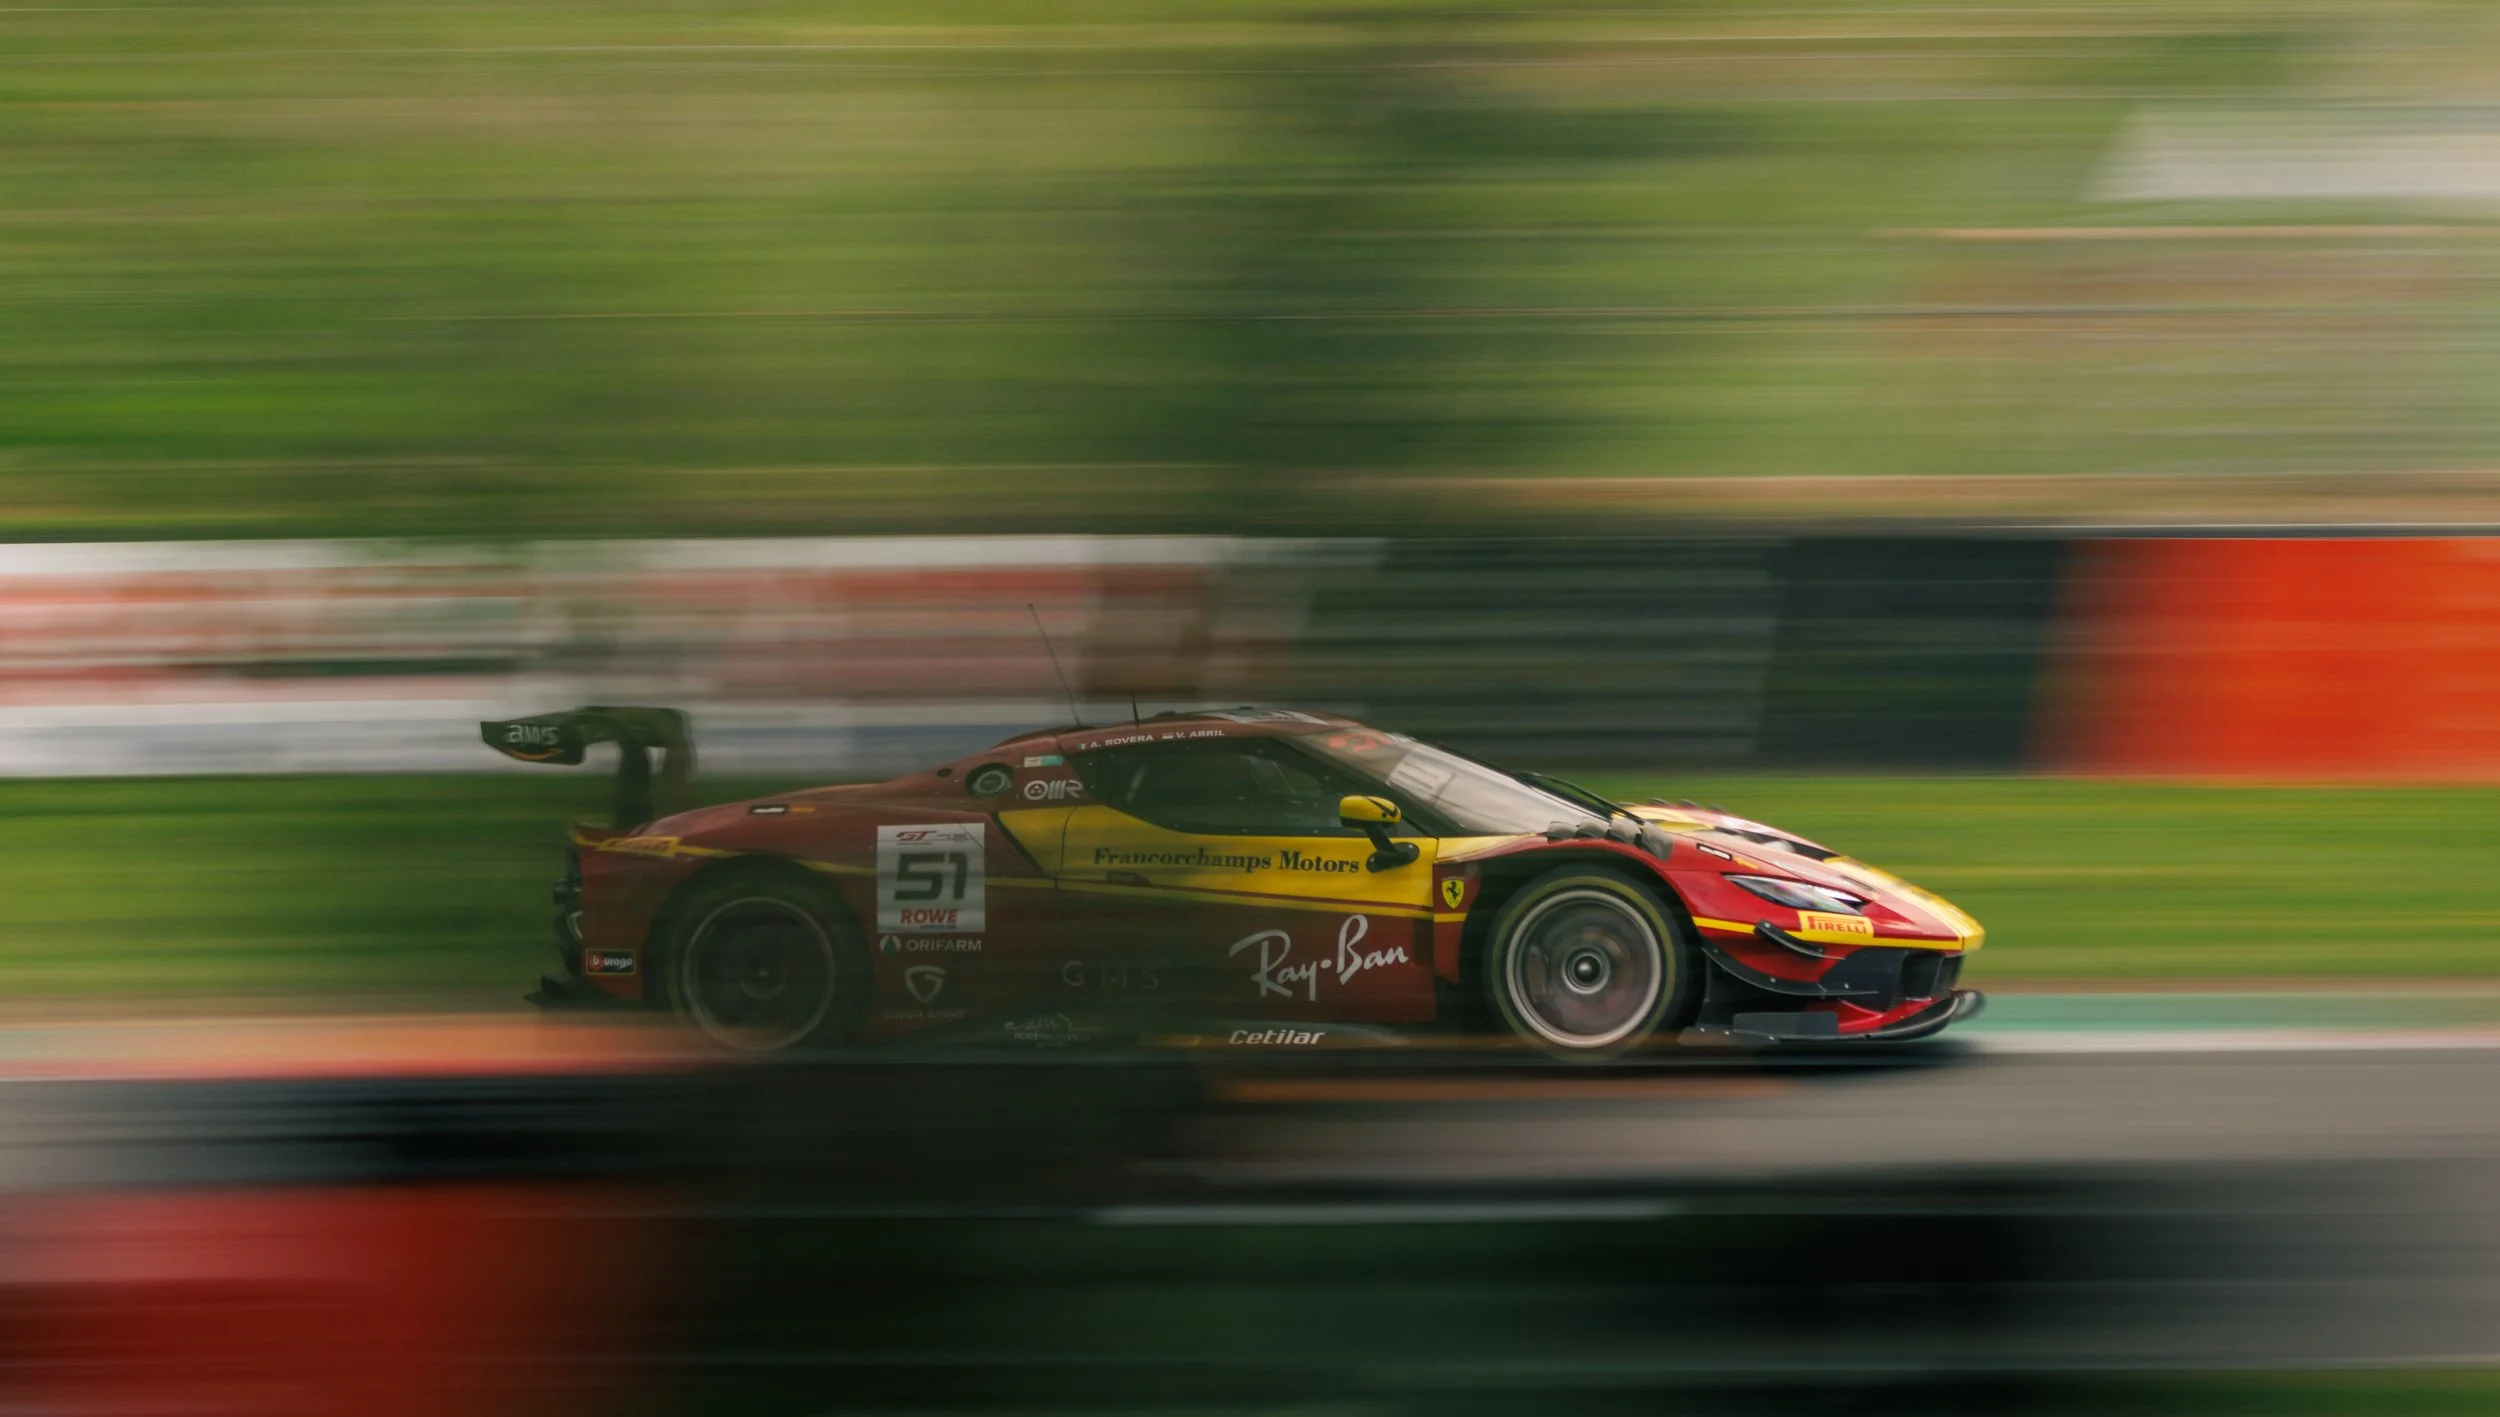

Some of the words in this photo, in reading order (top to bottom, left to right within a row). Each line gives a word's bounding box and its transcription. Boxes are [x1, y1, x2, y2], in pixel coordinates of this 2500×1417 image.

[507, 724, 558, 745] aws
[1105, 734, 1153, 746] ROVERA
[1189, 729, 1225, 738] ABRIL
[1094, 847, 1271, 874] Francorchamps
[1278, 850, 1360, 873] Motors
[894, 852, 968, 901] 51
[900, 908, 958, 924] ROWE
[1807, 915, 1868, 935] PIRELLI
[906, 939, 982, 952] ORIFARM
[1229, 1029, 1326, 1045] Cetilar
